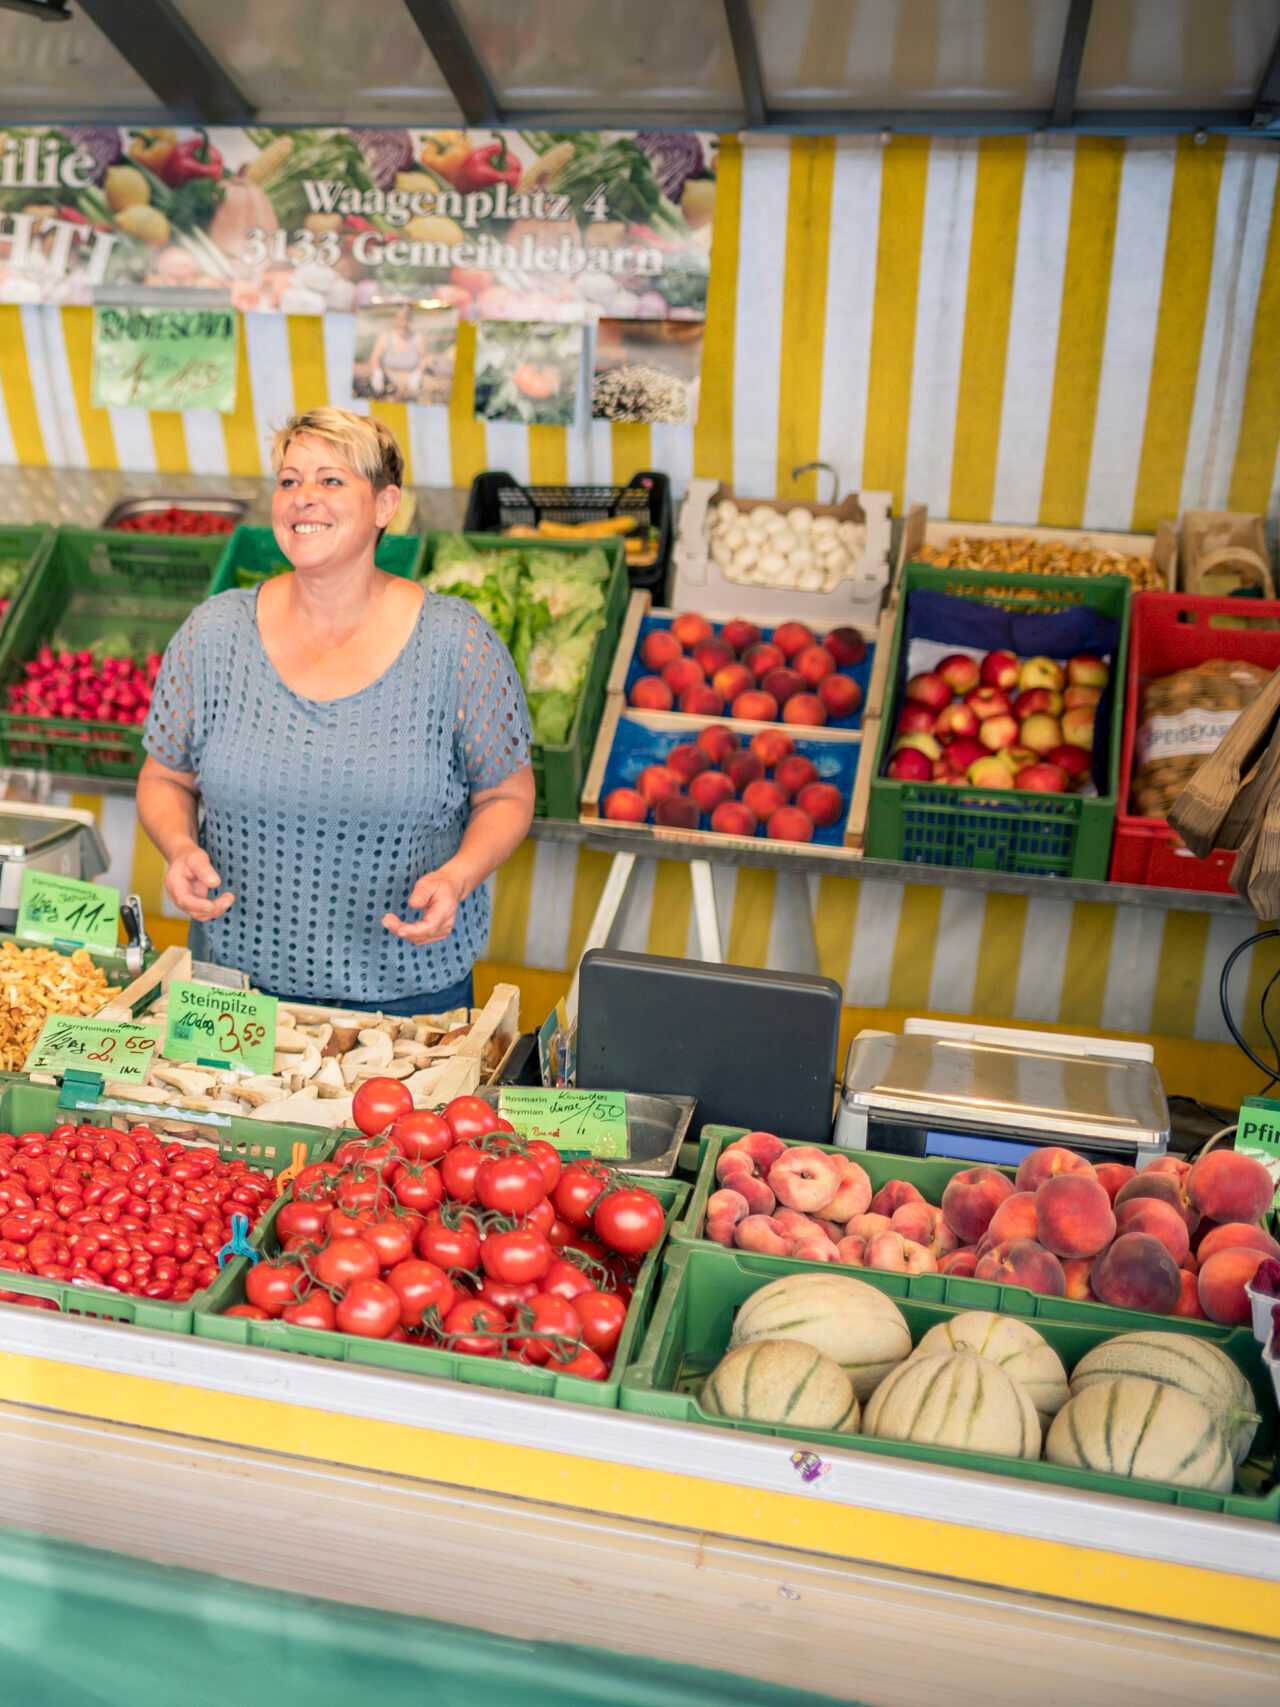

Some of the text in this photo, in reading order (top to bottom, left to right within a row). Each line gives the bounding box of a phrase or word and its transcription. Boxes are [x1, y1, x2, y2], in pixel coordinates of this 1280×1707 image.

[302, 179, 610, 228] Waagenplatz 4
[241, 228, 663, 276] 3133 Gemeinlebarn
[181, 990, 257, 1017] Steinpilze
[56, 1021, 122, 1034] Cherrytomaten
